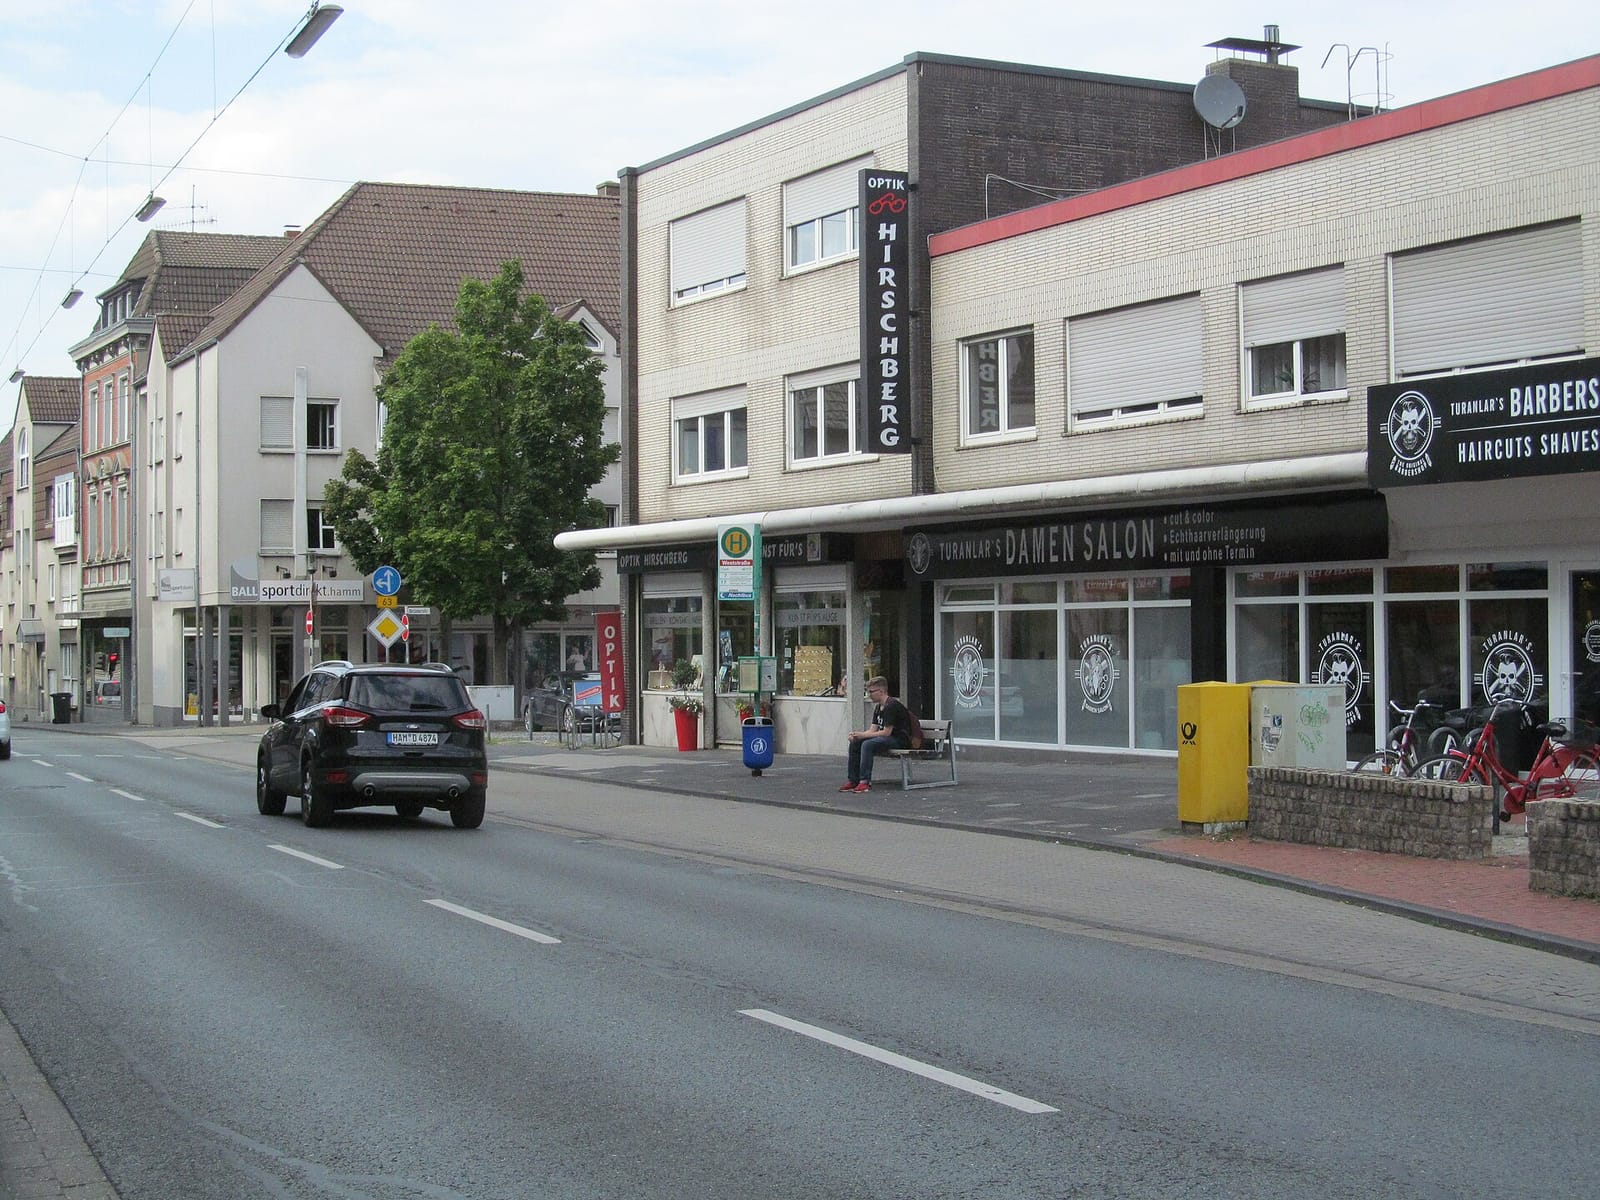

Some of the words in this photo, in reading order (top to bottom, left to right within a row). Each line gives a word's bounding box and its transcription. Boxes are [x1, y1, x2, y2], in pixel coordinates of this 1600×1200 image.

[868, 177, 905, 190] OPTIK
[878, 222, 900, 447] HIRSCHBERG
[1450, 397, 1504, 416] TURANLAR'S
[1510, 377, 1600, 418] BARBERS
[1458, 434, 1532, 463] HAIRCUTS
[1540, 429, 1600, 455] SHAVES
[1169, 511, 1183, 525] cut
[1184, 509, 1190, 524] &
[1192, 508, 1214, 523] color
[729, 534, 742, 551] H
[939, 538, 1001, 560] TURANLAR'S
[1006, 525, 1074, 565] DAMEN
[1083, 519, 1154, 561] SALON
[1170, 526, 1266, 543] Echthaarverlängerung
[779, 540, 803, 557] FÜR'S
[1170, 548, 1184, 562] mit
[1185, 547, 1200, 561] und
[1203, 546, 1223, 561] ohne
[1225, 544, 1255, 559] Termin
[620, 554, 641, 568] OPTIK
[643, 550, 688, 567] HIRSCHBERG
[231, 586, 258, 597] BALL
[262, 584, 361, 599] sportdirkt.hamm
[382, 598, 393, 606] 63
[1318, 631, 1361, 651] TURANLAR'S
[1482, 630, 1534, 651] TURANLAR'S
[604, 625, 621, 709] OPTIK
